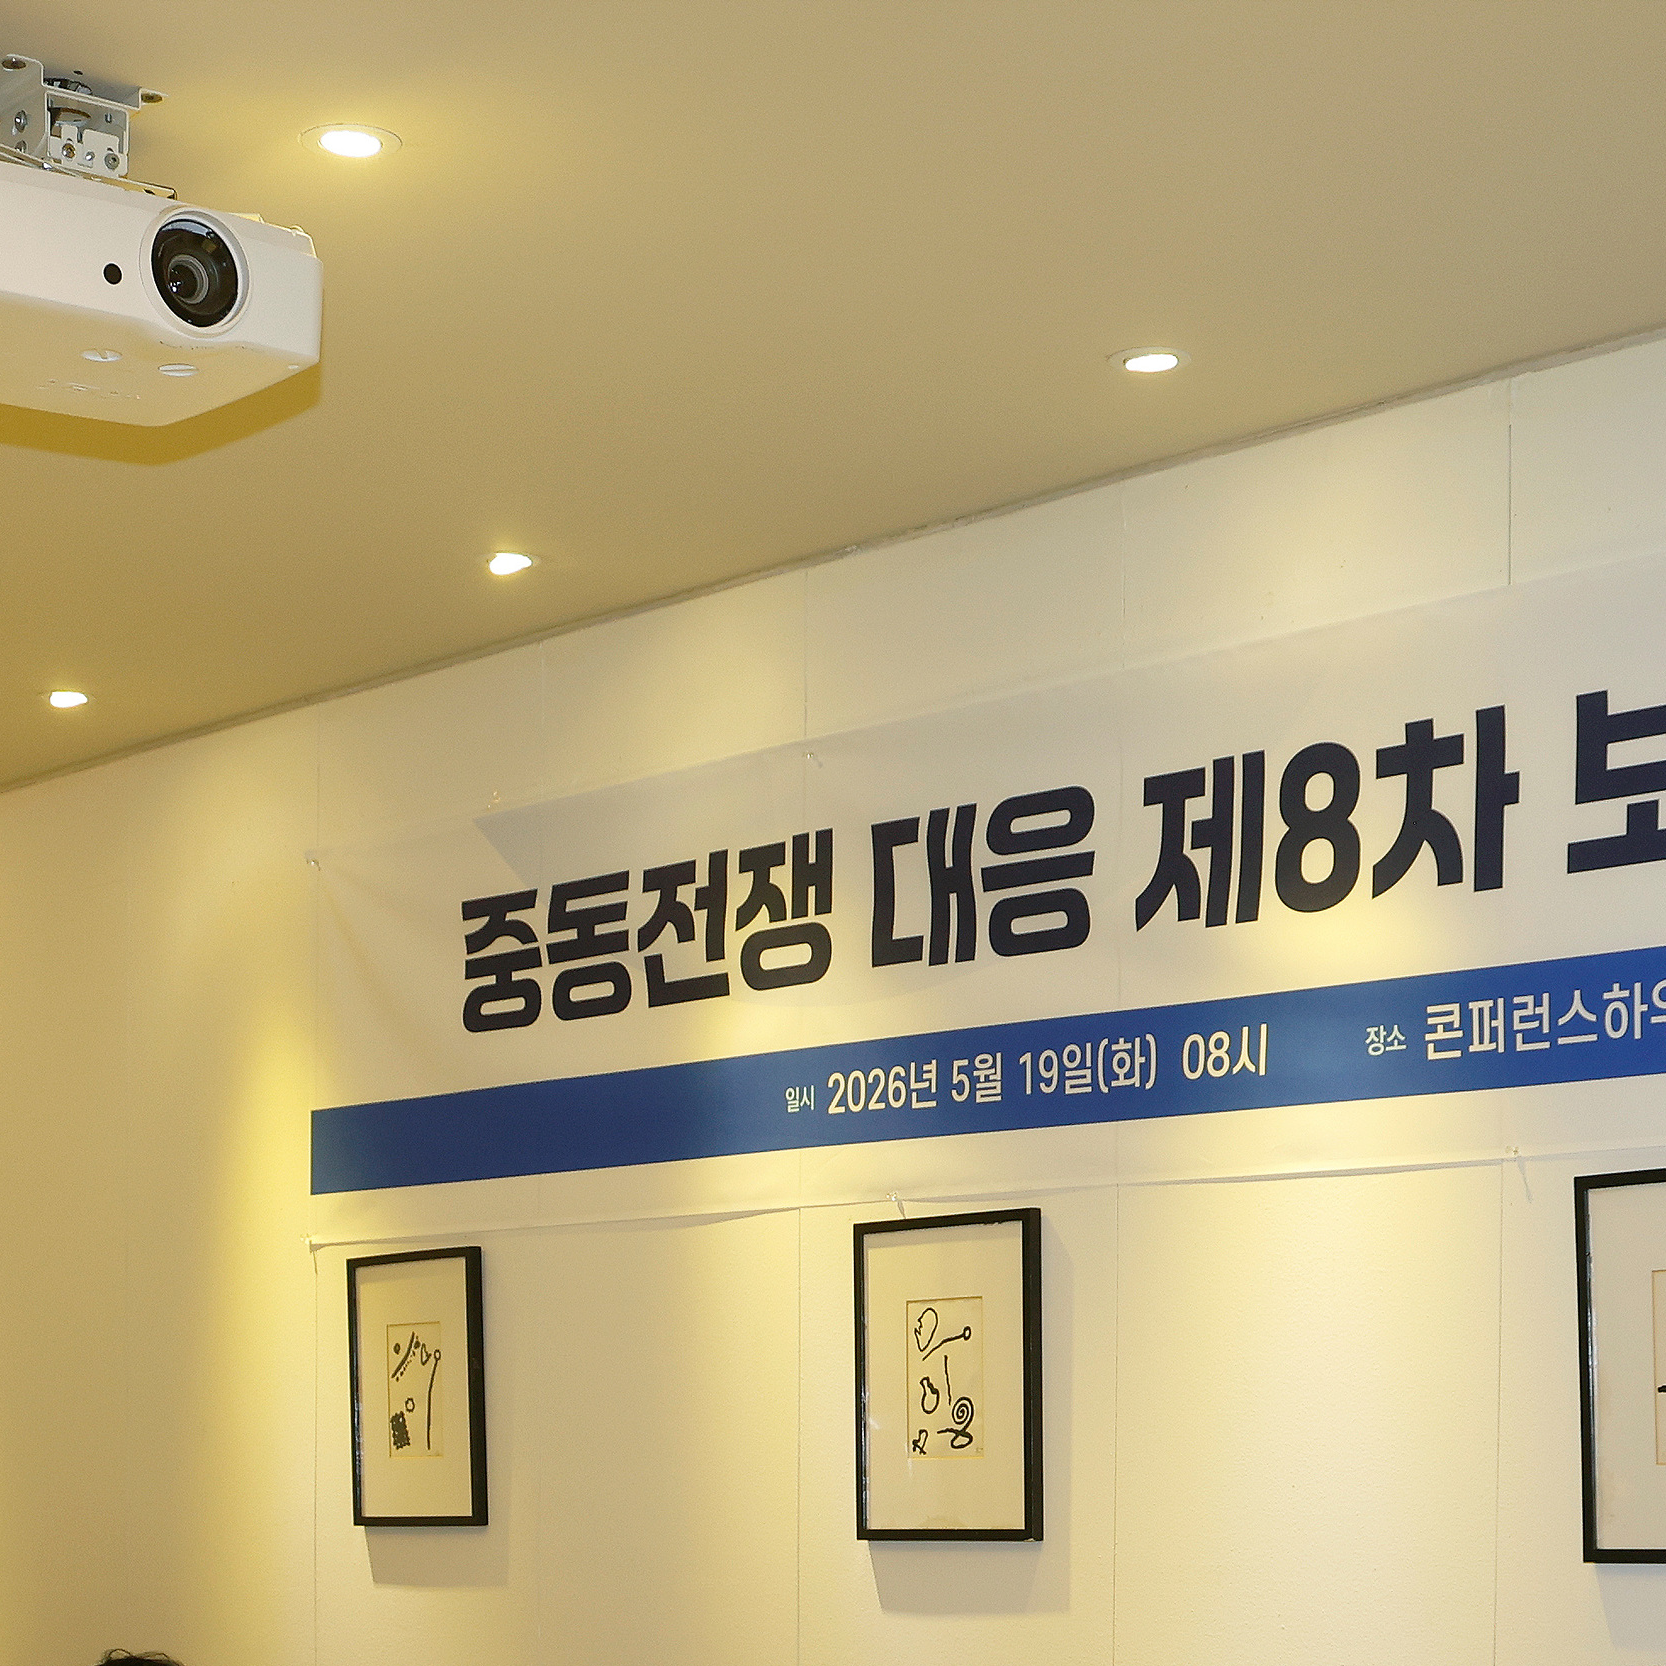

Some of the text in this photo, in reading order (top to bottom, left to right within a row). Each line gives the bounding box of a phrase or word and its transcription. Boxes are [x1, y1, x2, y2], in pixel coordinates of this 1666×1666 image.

[462, 828, 833, 1033] 중동전쟁
[871, 786, 1095, 968] 대응
[1135, 705, 1519, 932] 제8차
[786, 1024, 1267, 1114] 일시 2026년 5월 19일(화) 08시
[1365, 1024, 1407, 1056] 장소
